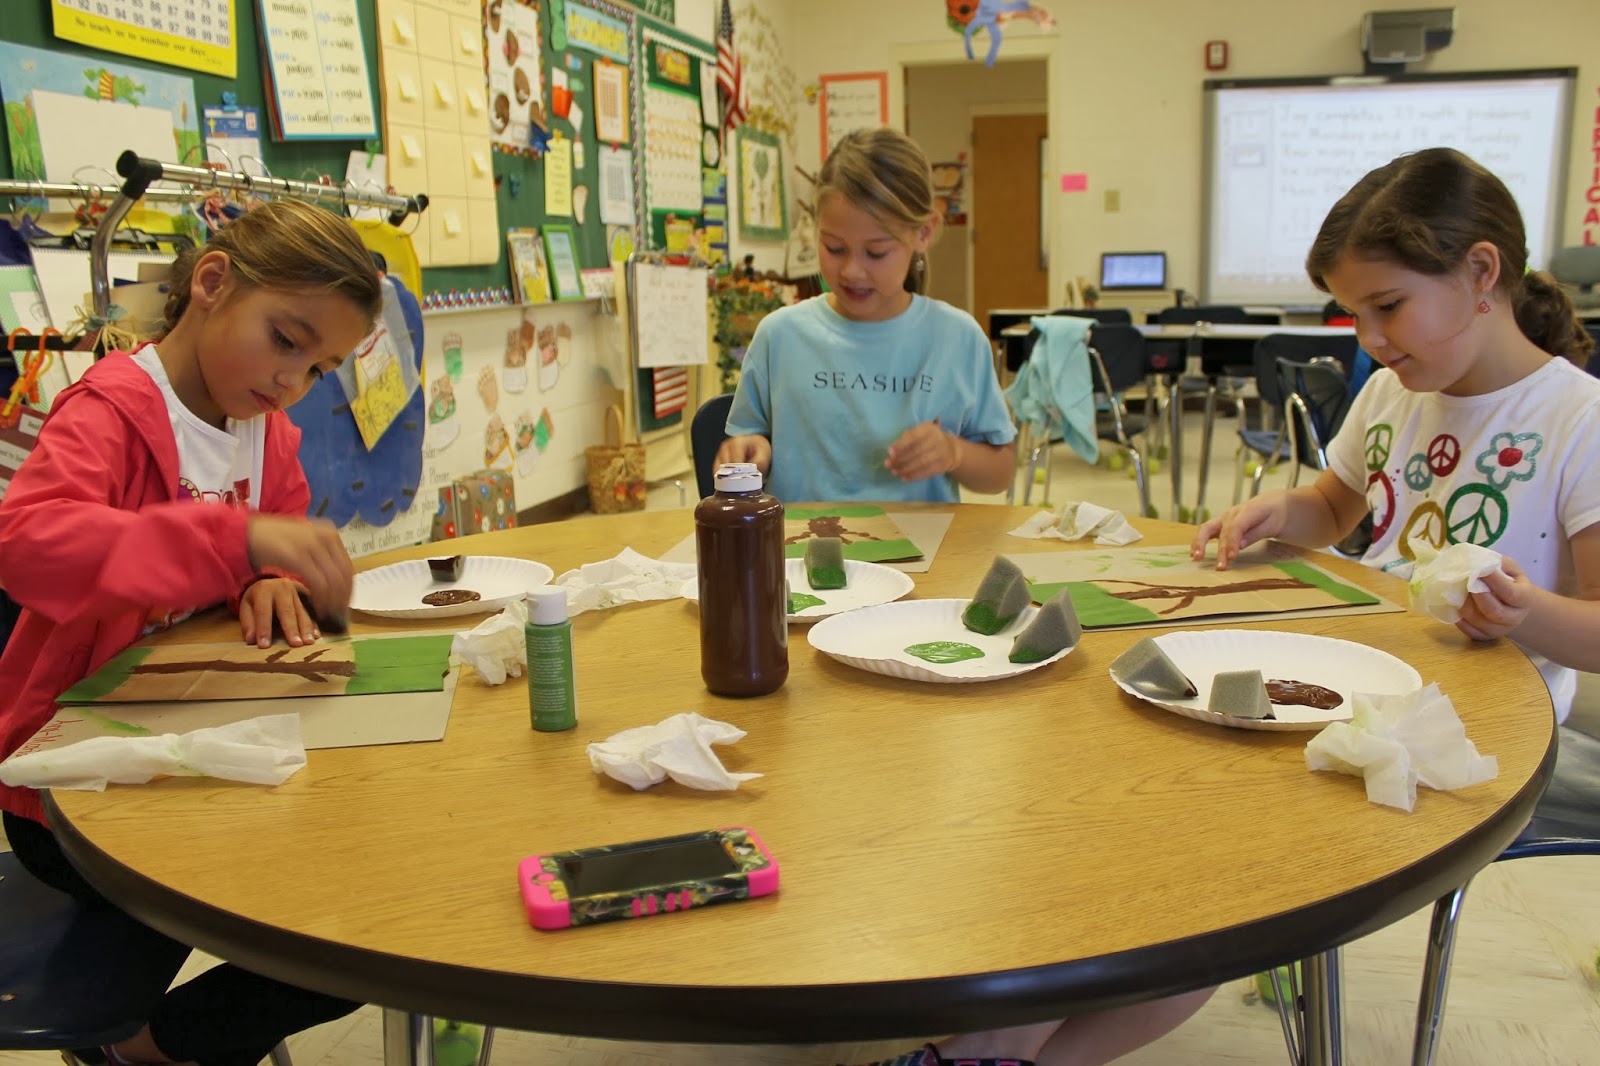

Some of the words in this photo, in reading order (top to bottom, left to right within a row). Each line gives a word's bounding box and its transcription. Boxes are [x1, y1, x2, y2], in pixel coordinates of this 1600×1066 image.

[79, 0, 91, 12] 92
[96, 2, 109, 16] 93
[114, 7, 127, 20] 94
[132, 12, 145, 26] 95
[151, 16, 163, 30] 96
[168, 21, 180, 33] 97
[185, 25, 197, 37] 98
[201, 29, 213, 41] 99
[216, 33, 230, 46] 100
[167, 3, 179, 16] 87
[184, 9, 196, 21] 88
[201, 12, 212, 25] 89
[218, 17, 229, 30] 90
[89, 20, 112, 36] teach
[114, 30, 125, 38] us
[127, 32, 137, 41] to
[140, 35, 170, 49] number
[813, 371, 934, 393] SEASIDE
